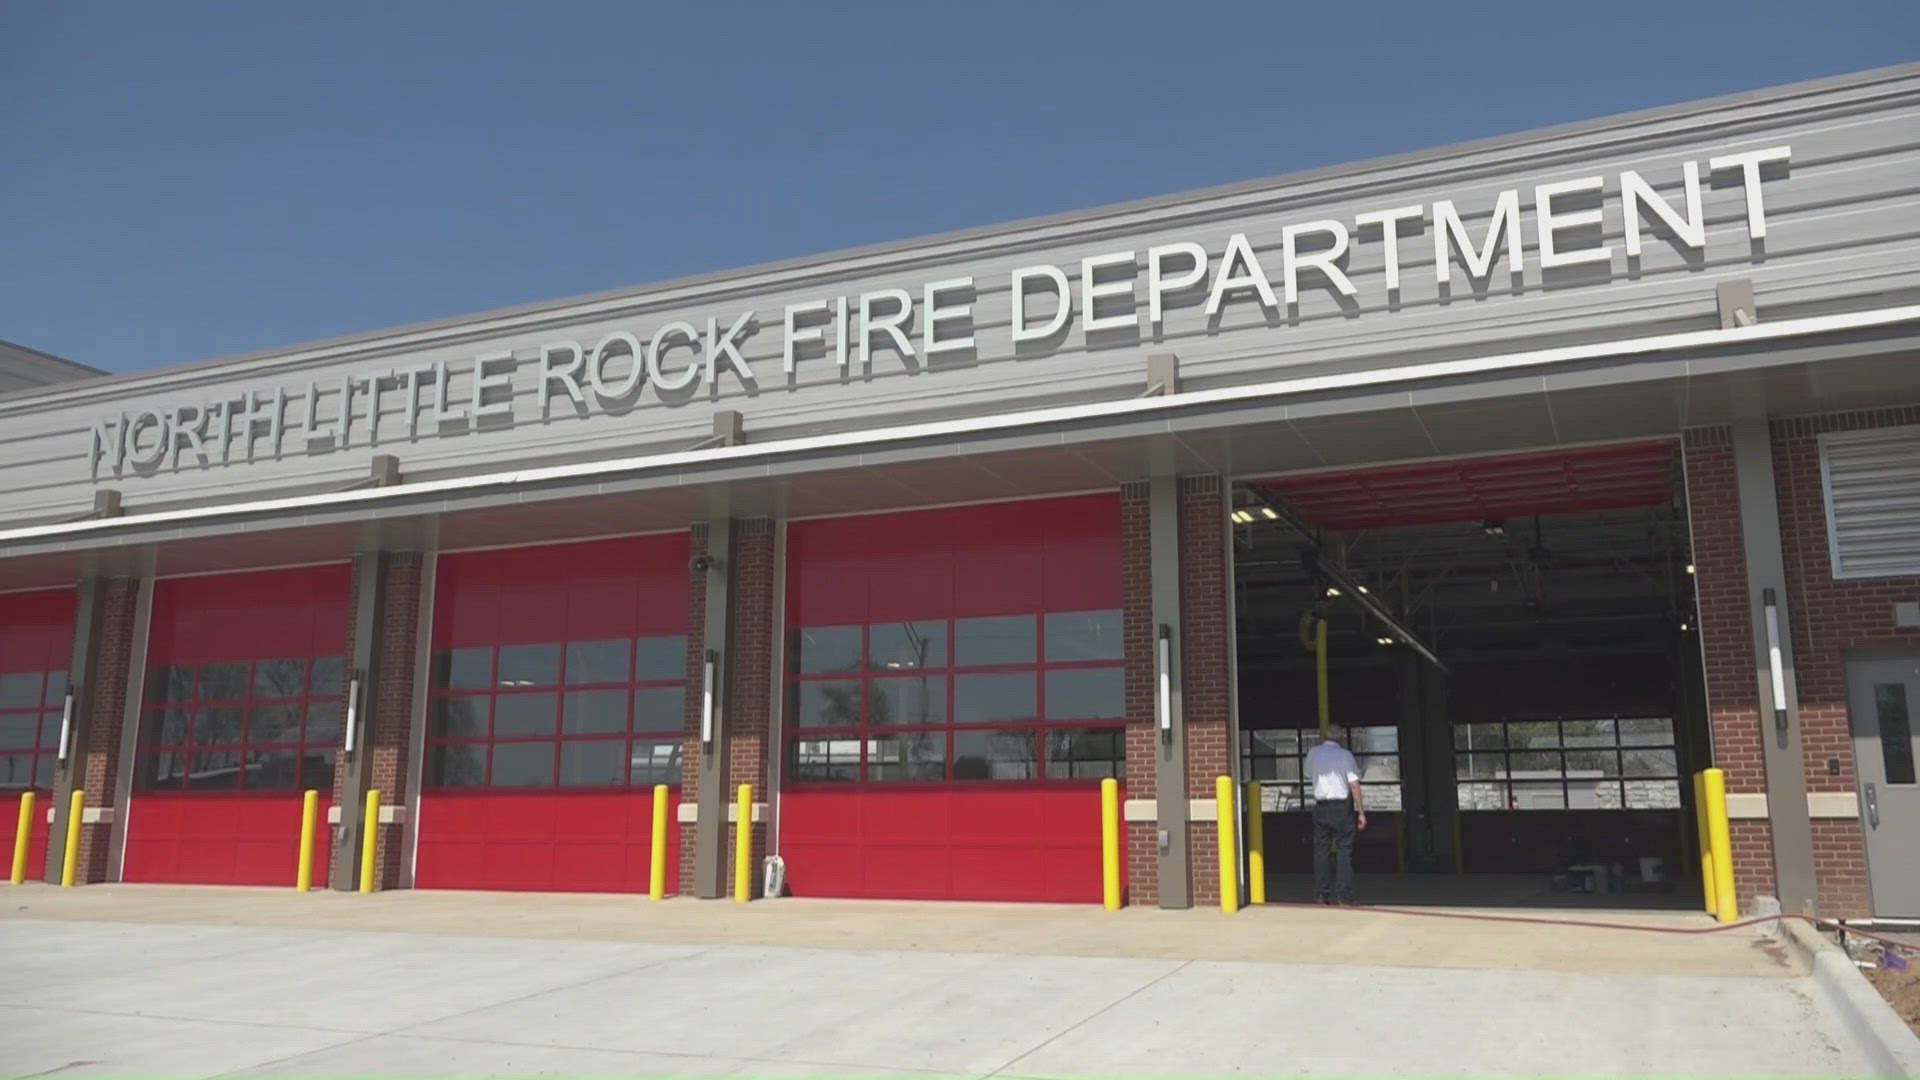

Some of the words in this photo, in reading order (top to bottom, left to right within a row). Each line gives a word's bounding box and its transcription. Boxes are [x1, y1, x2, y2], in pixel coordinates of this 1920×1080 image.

[92, 386, 284, 476] NORTH
[303, 352, 516, 439] LITTLE
[539, 311, 757, 407] ROCK
[783, 277, 975, 374] FIRE
[1010, 145, 1792, 343] DEPARTMENT
